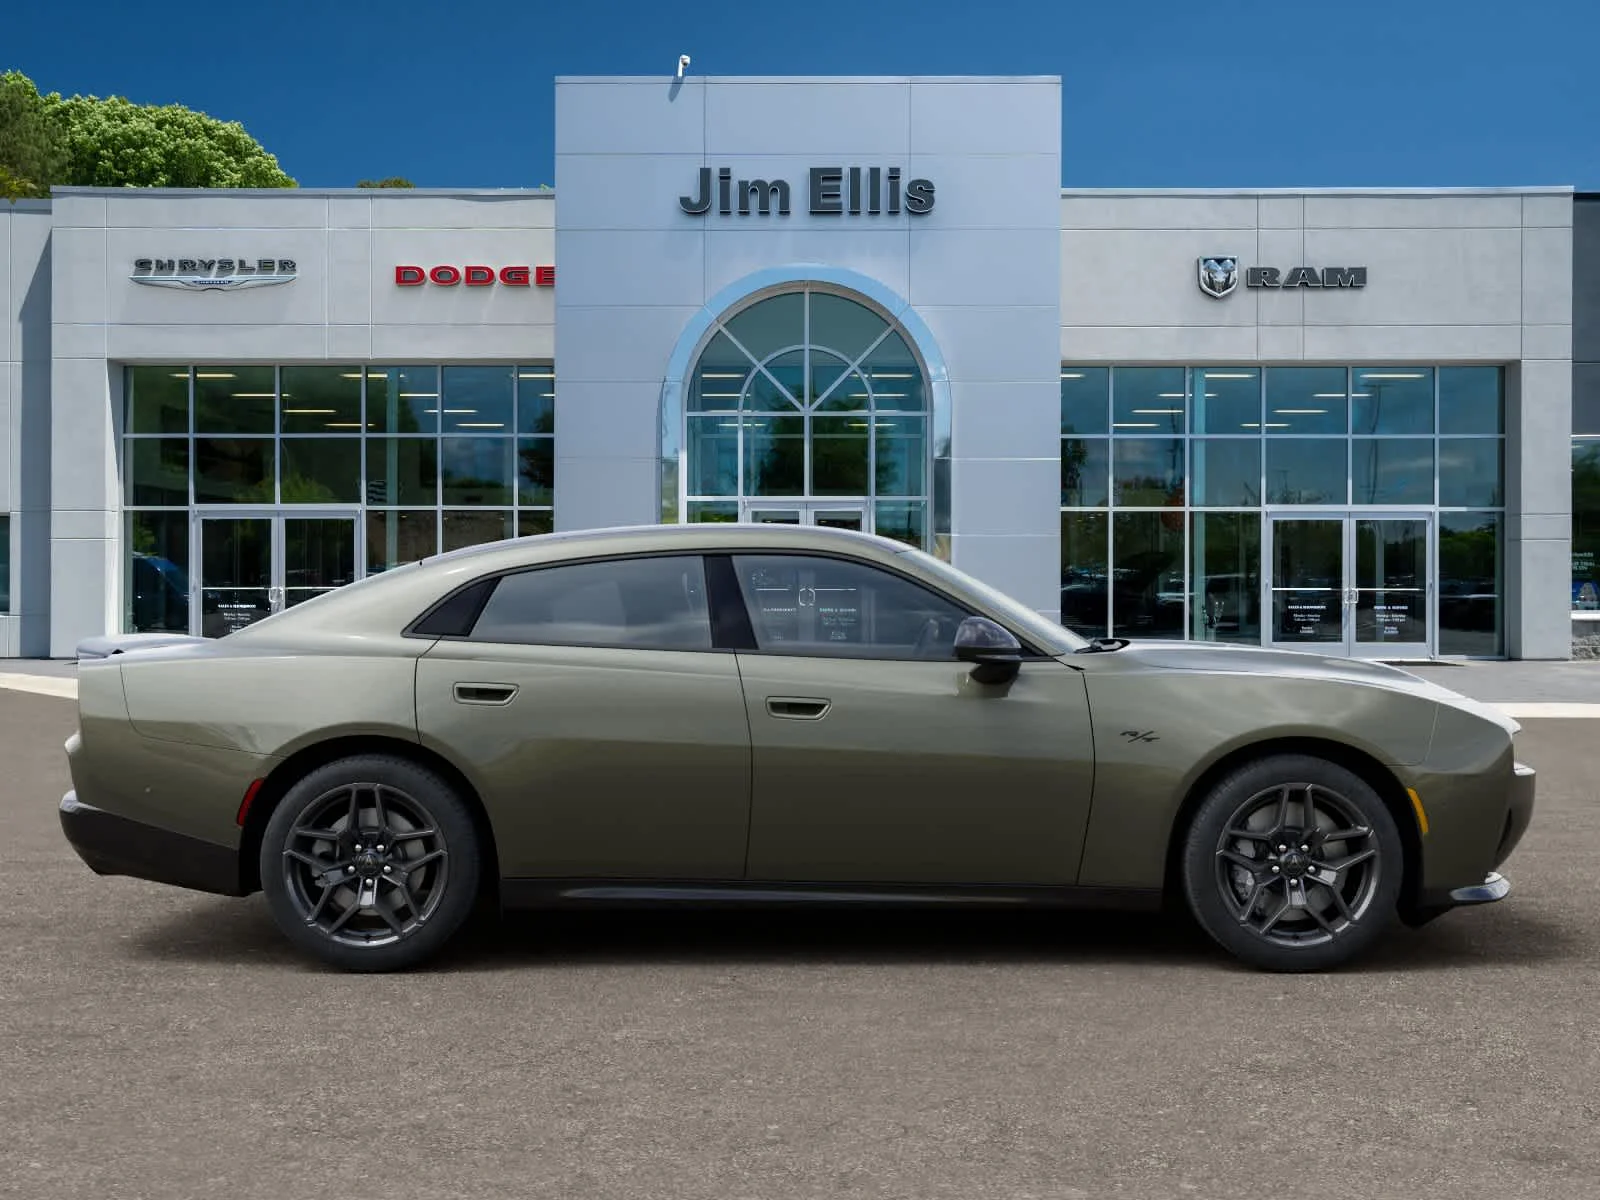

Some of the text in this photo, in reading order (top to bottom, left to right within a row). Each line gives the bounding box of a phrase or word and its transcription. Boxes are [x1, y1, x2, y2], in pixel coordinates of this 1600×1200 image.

[679, 167, 936, 215] Jim Ellis
[135, 258, 297, 272] CHRYSLER
[395, 265, 555, 287] DODGE
[1247, 266, 1367, 289] RAM
